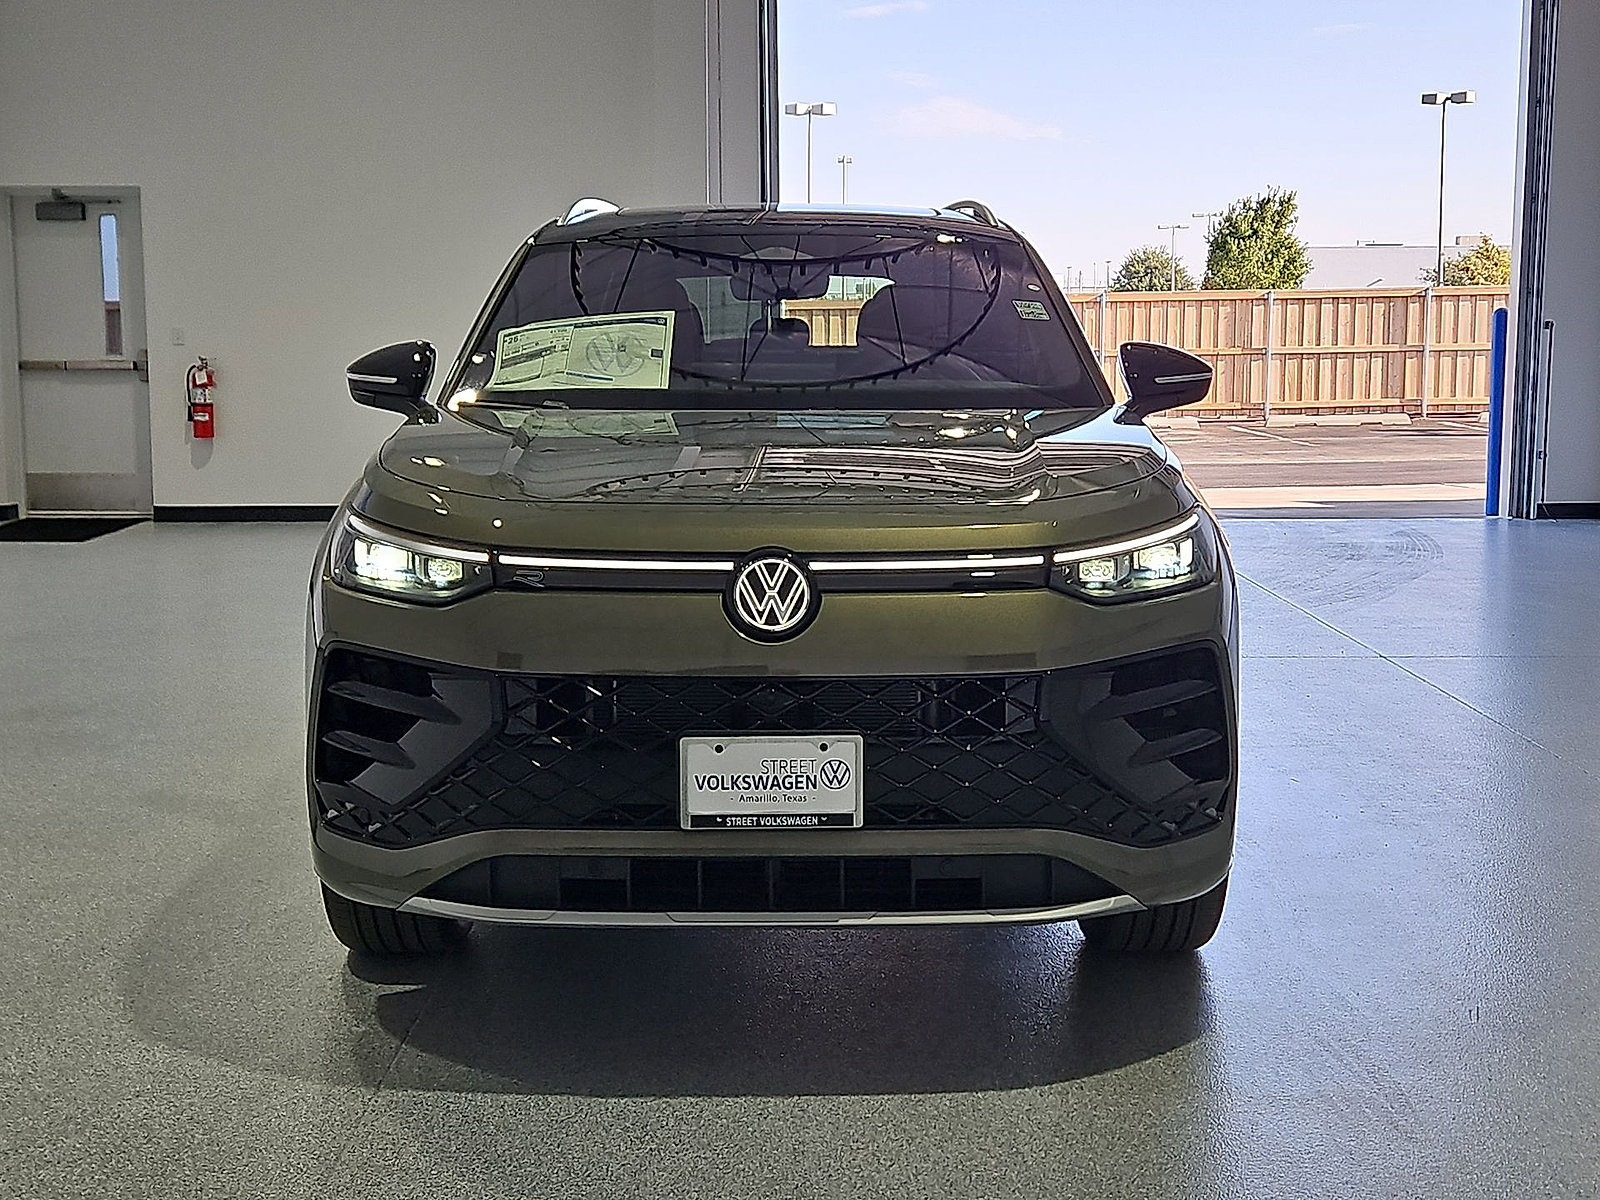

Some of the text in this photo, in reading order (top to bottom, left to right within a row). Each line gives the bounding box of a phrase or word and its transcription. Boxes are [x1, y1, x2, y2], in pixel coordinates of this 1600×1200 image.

[760, 759, 817, 775] STREET
[694, 774, 818, 791] VOLKSWAGEN
[738, 793, 808, 803] Amarillo, Texas
[726, 816, 818, 826] STREET VOLKSWAGEN
